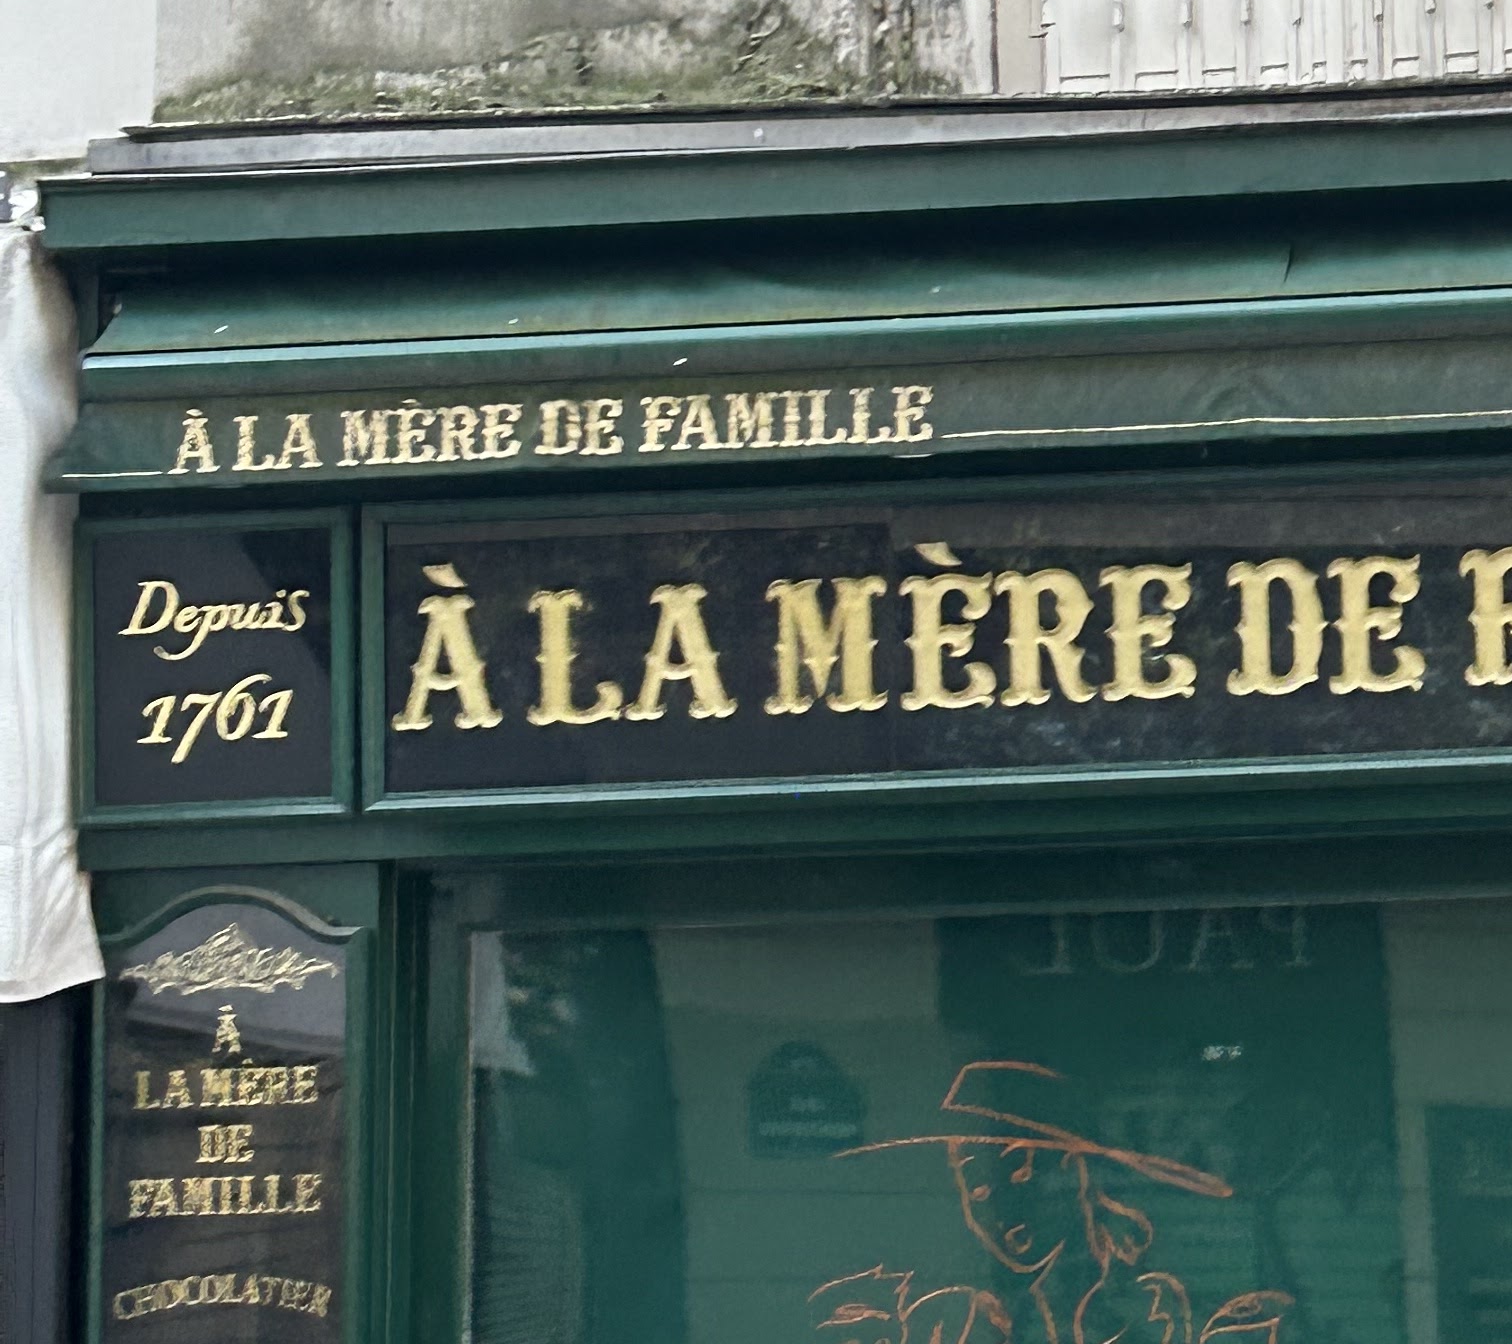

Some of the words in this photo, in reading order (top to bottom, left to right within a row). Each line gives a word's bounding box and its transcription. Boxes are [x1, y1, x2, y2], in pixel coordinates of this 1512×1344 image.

[167, 408, 219, 475] À
[231, 413, 323, 471] LA
[338, 399, 523, 467] MÈRE
[532, 397, 624, 458] DE
[639, 385, 935, 451] FAMILLE
[117, 580, 310, 661] Depuis
[393, 562, 502, 732] À
[526, 580, 739, 725] LA
[762, 541, 1198, 718] MÈRE
[1225, 553, 1426, 697] DE
[136, 673, 294, 764] 1761
[211, 1004, 242, 1054] À
[132, 1070, 195, 1109] LA
[199, 1058, 320, 1107] MÈRE
[195, 1123, 255, 1164] DE
[128, 1173, 323, 1219] FAMILLE
[112, 1272, 333, 1320] CHOCOLATIER
